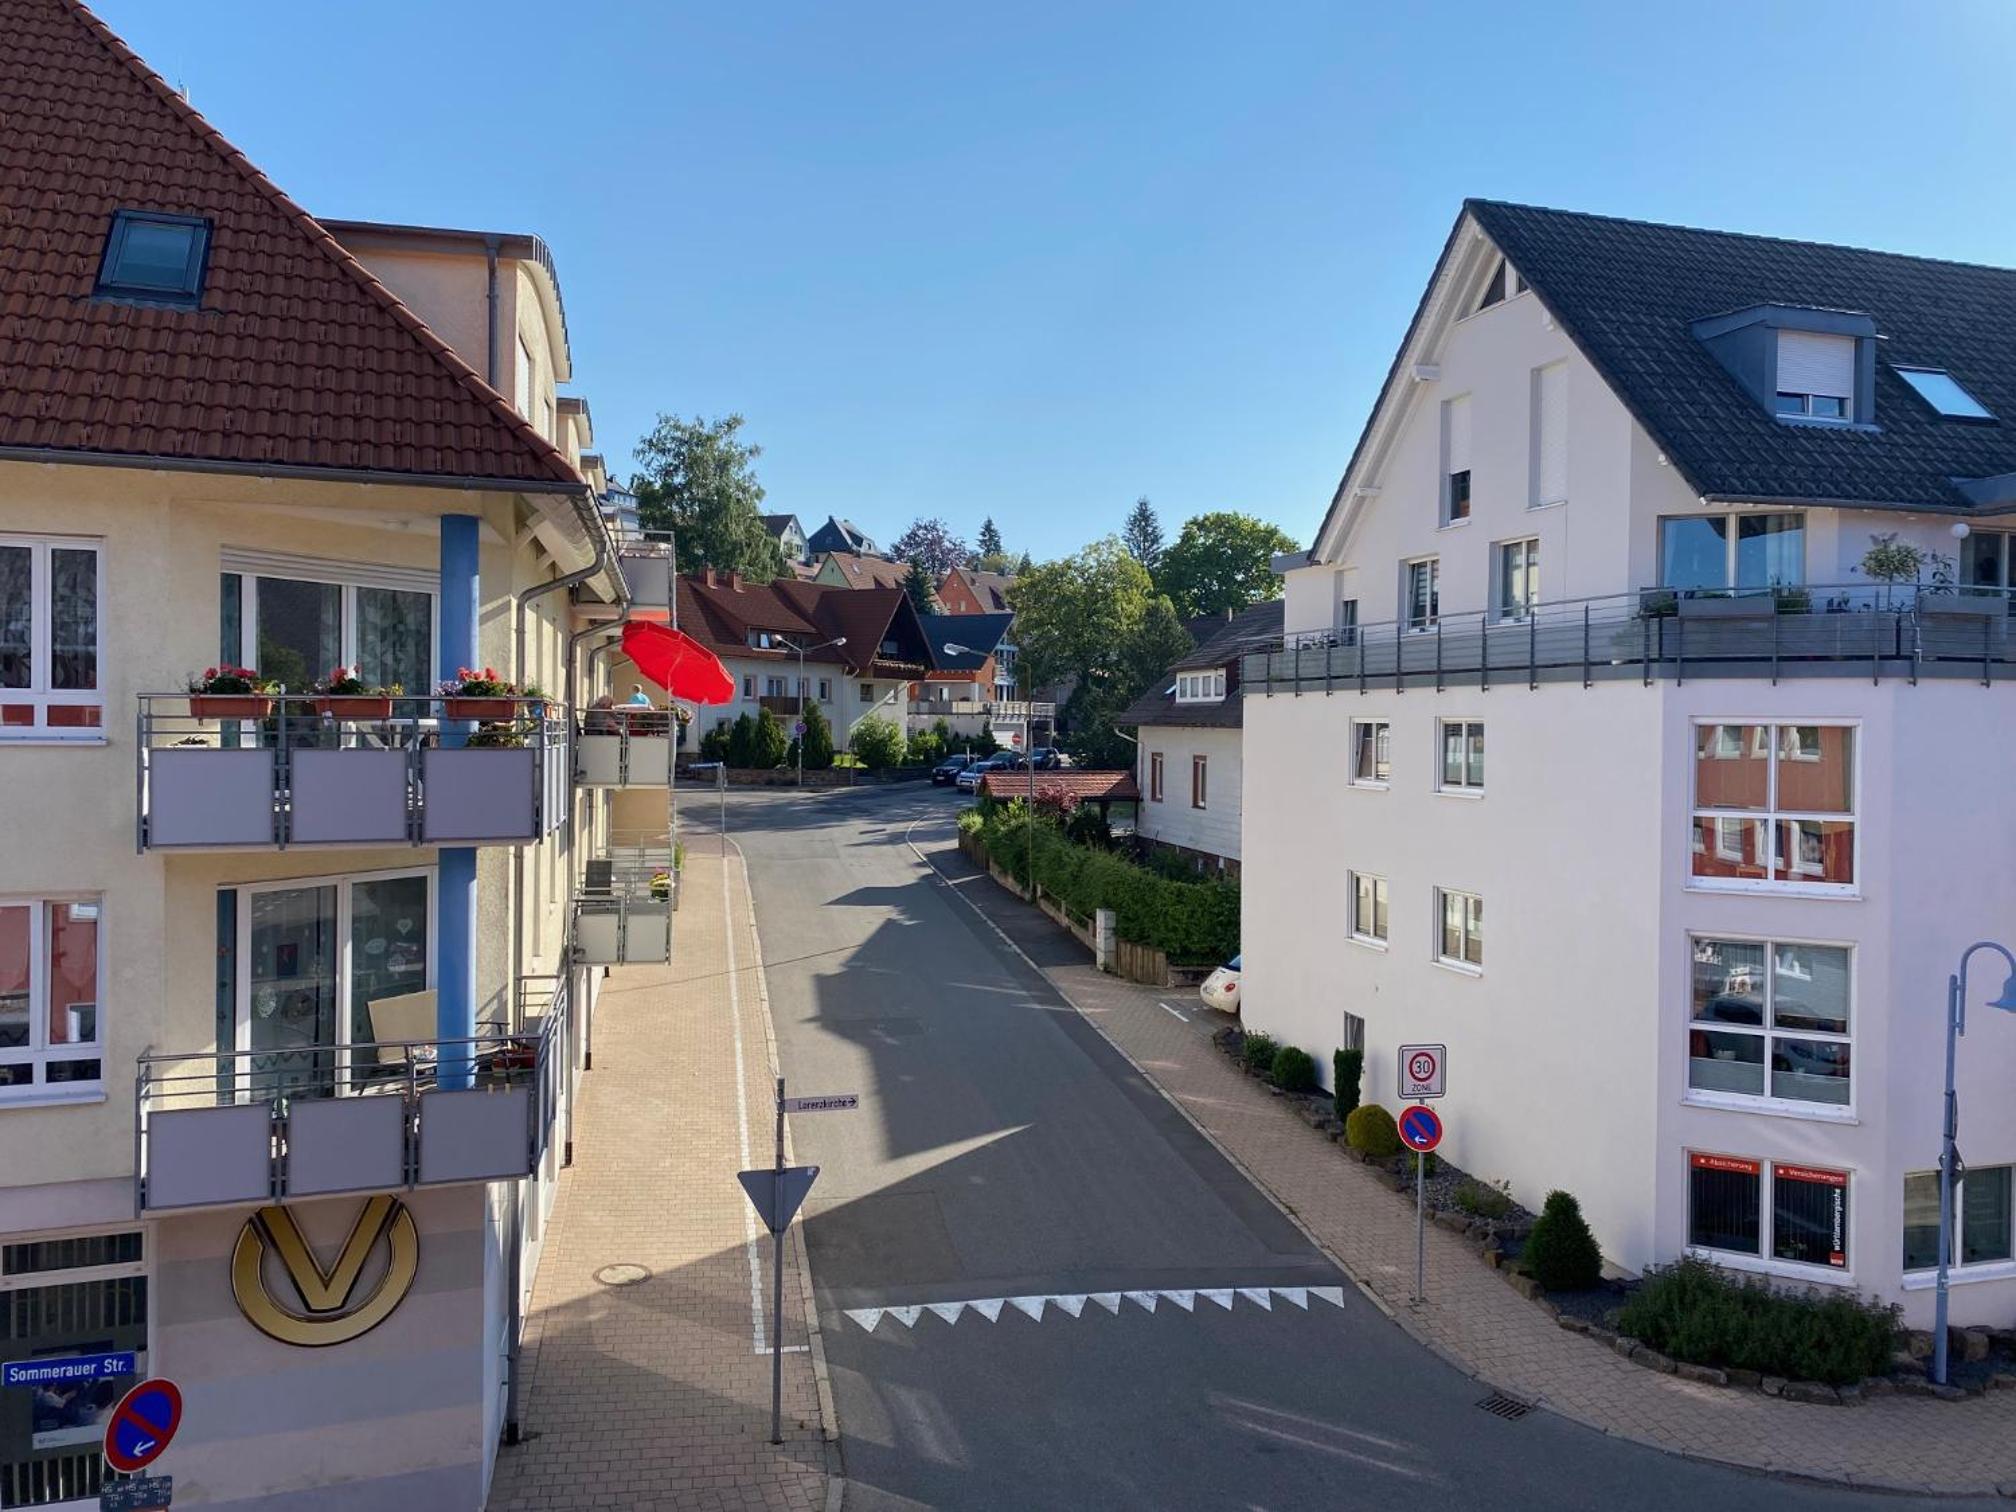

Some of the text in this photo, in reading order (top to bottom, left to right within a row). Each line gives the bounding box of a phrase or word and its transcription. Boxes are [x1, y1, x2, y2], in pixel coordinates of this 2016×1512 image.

[1414, 1060, 1431, 1074] 30
[1411, 1084, 1432, 1092] ZONE
[9, 1358, 127, 1382] Sommerauer Str.
